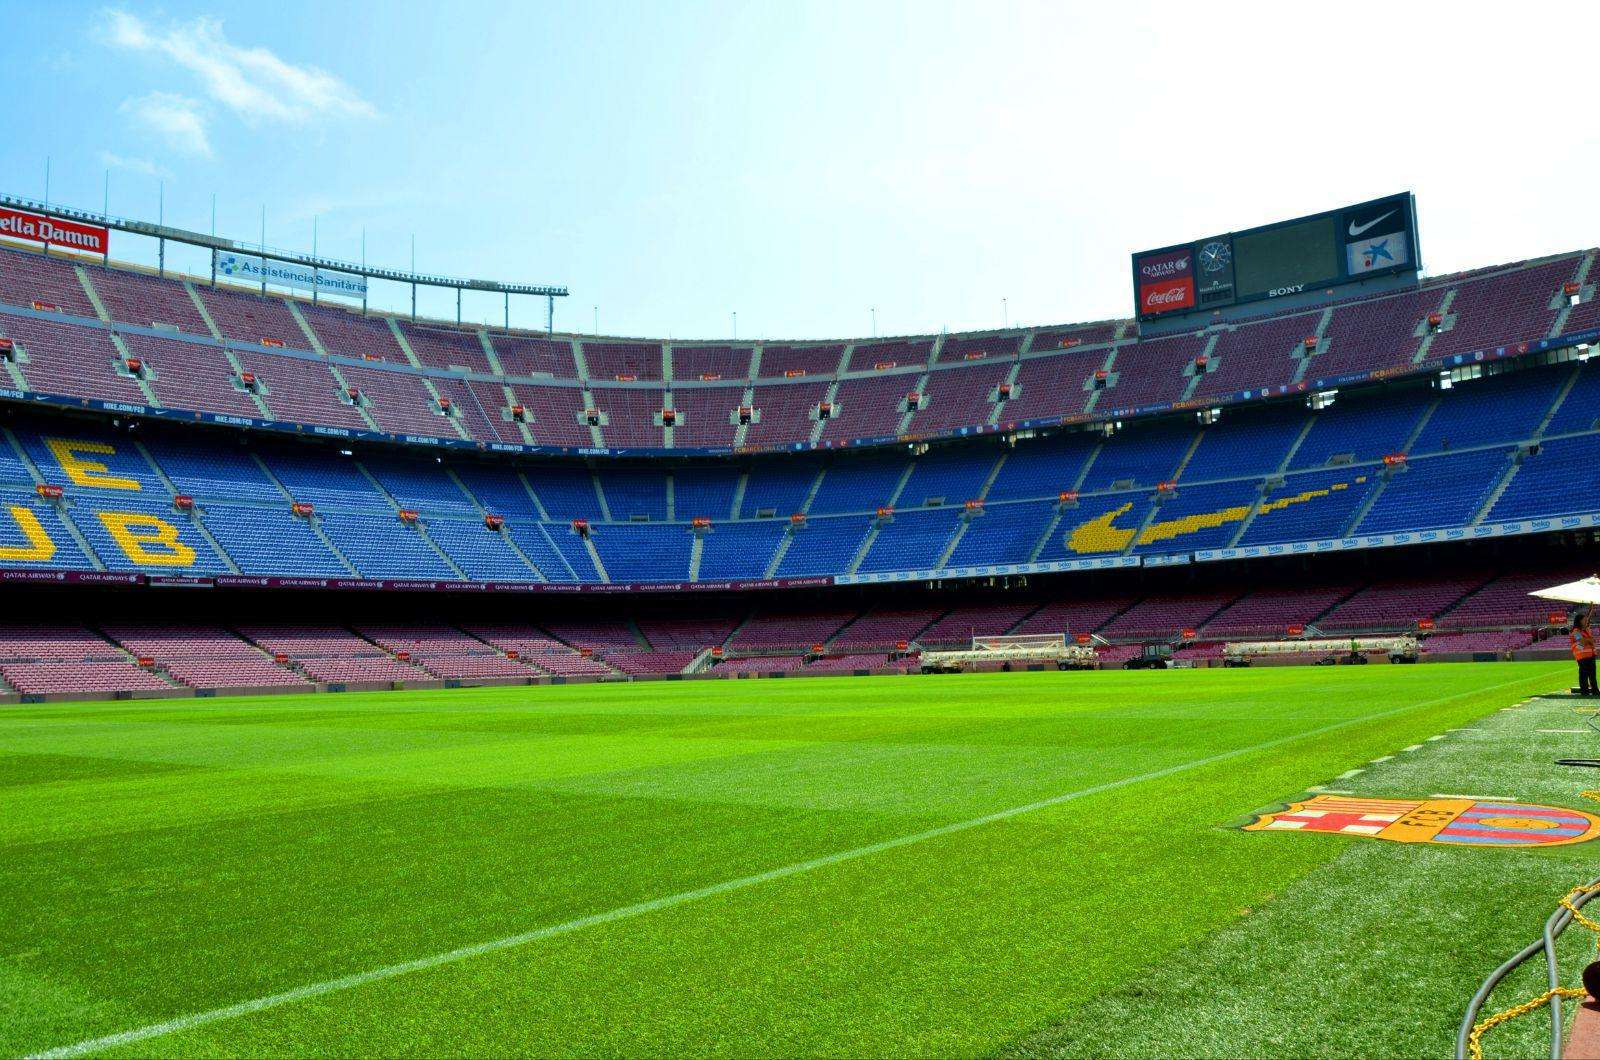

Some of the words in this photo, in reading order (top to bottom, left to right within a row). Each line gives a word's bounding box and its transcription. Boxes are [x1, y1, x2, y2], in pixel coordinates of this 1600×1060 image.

[37, 220, 100, 248] Damm
[1142, 261, 1175, 275] QATAR
[1151, 269, 1176, 278] AIRWAYS
[1269, 284, 1304, 297] SONY
[103, 402, 145, 414] NIKE.COM/FCB
[80, 573, 101, 581] QATAR
[102, 574, 129, 582] AIRWAYS
[217, 577, 237, 585] QATAR
